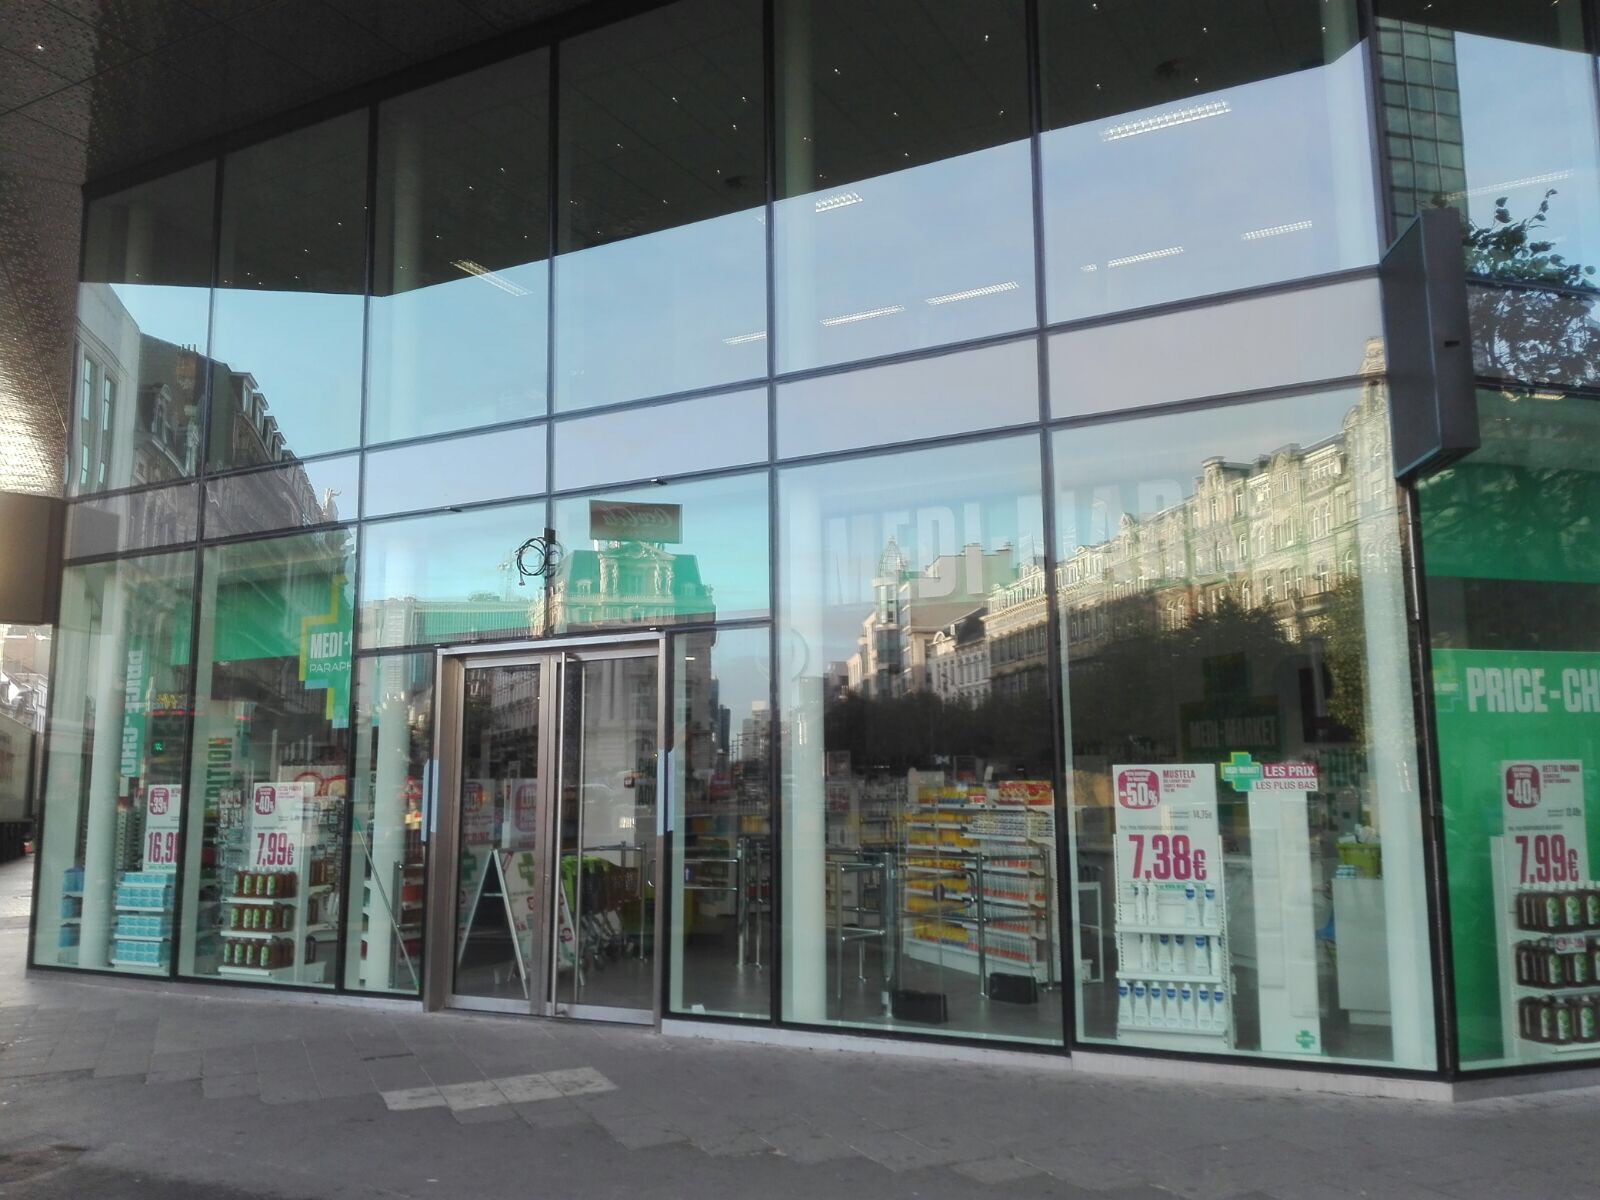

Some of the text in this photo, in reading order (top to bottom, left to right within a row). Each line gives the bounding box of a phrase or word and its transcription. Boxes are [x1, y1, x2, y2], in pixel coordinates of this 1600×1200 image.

[1465, 667, 1600, 714] PRICE-CH
[1163, 769, 1196, 779] MUSTELA
[1264, 763, 1315, 777] LES PRIX
[1119, 782, 1158, 806] -50%
[1255, 781, 1316, 791] LES PLUS BAS
[256, 832, 295, 867] 7,99€
[1128, 834, 1207, 881] 7,38€
